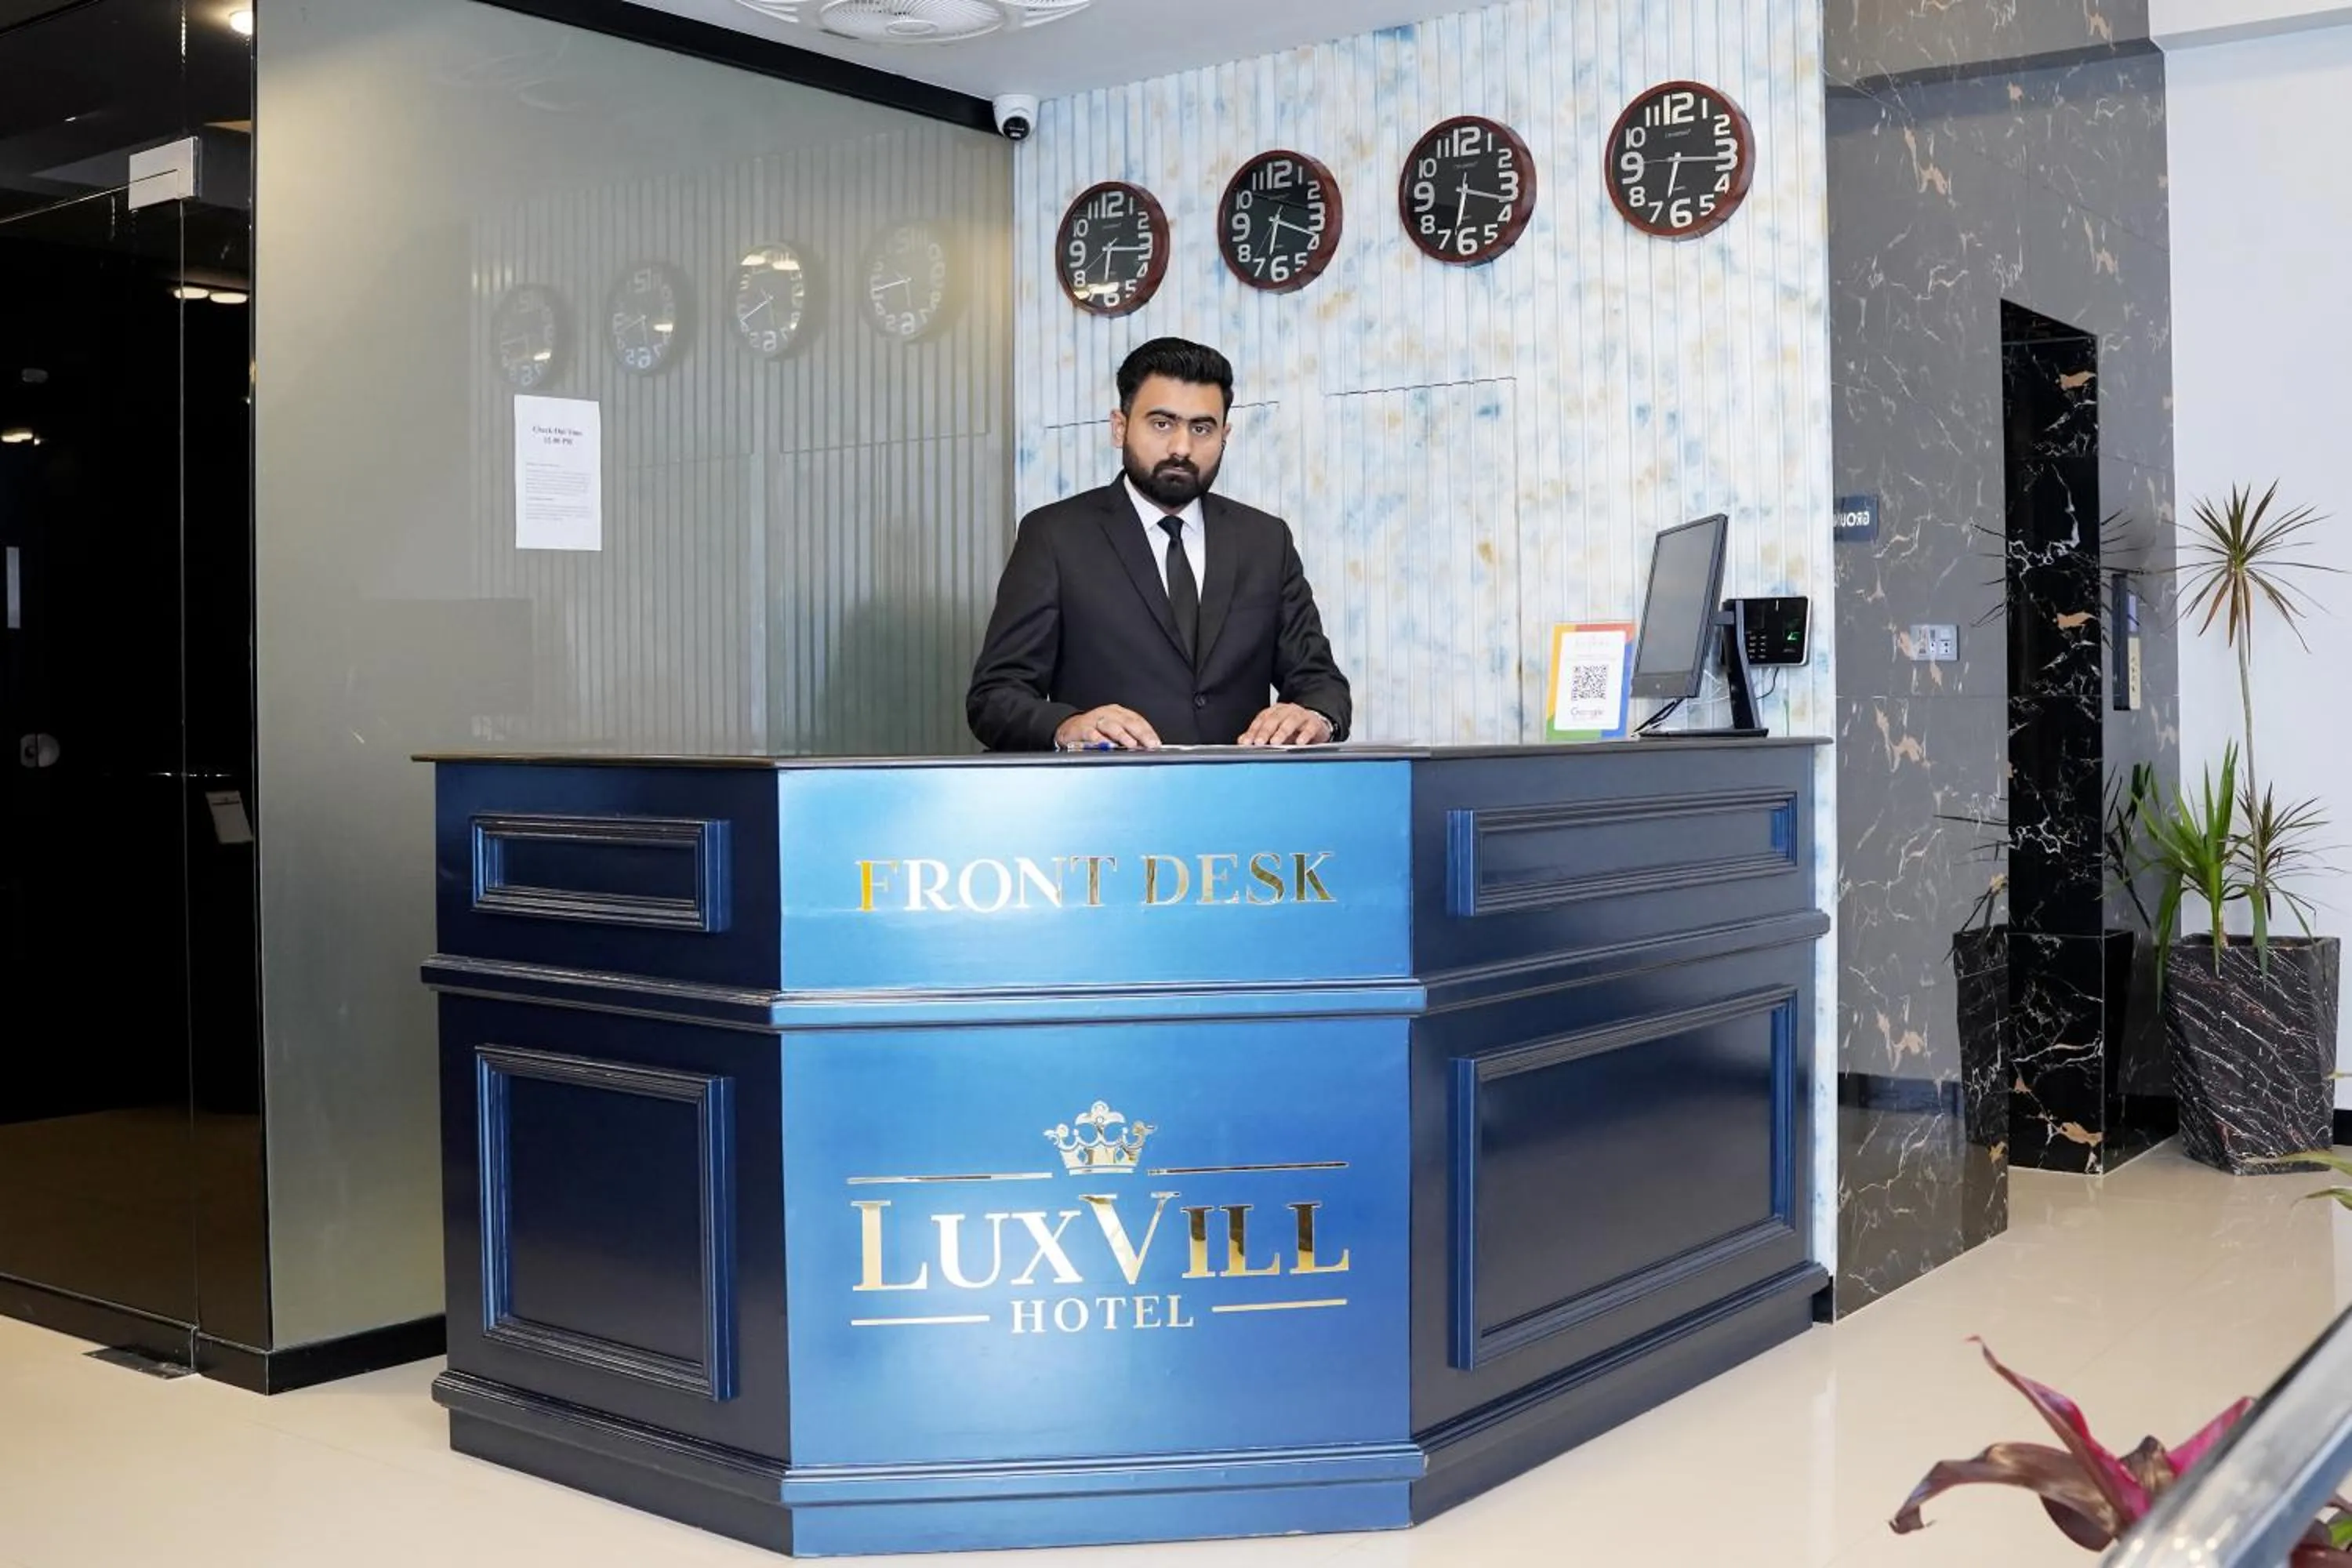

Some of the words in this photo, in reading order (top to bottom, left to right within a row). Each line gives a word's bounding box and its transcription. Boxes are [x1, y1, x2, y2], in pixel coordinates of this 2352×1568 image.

[1646, 105, 1660, 127] 11
[1663, 92, 1694, 125] 12
[1702, 98, 1708, 119] 1
[1713, 114, 1730, 136] 2
[1437, 137, 1449, 159] 11
[1453, 126, 1481, 158] 12
[1487, 132, 1492, 152] 1
[1625, 127, 1646, 150] 10
[1497, 148, 1512, 169] 2
[1715, 137, 1738, 172] 3
[1267, 159, 1293, 190] 12
[1298, 165, 1302, 185] 1
[1418, 158, 1437, 179] 10
[1621, 151, 1645, 185] 9
[1252, 171, 1265, 191] 11
[1307, 180, 1321, 200] 2
[1498, 170, 1519, 203] 3
[1101, 191, 1124, 219] 12
[1236, 190, 1252, 210] 10
[1414, 181, 1435, 212] 9
[1629, 186, 1646, 208] 8
[1699, 194, 1715, 216] 5
[1138, 212, 1149, 229] 2
[1308, 201, 1326, 232] 3
[1648, 200, 1664, 223] 7
[1669, 197, 1693, 228] 6
[1073, 219, 1089, 238] 10
[1232, 212, 1251, 242] 9
[1420, 214, 1436, 234] 8
[1484, 223, 1498, 245] 5
[1138, 232, 1153, 260] 3
[1437, 228, 1451, 250] 7
[1457, 227, 1478, 256] 6
[1069, 240, 1086, 267] 9
[1238, 244, 1251, 263] 8
[1073, 270, 1086, 288] 8
[1253, 258, 1266, 278] 7
[1270, 256, 1290, 282] 6
[855, 856, 1117, 913] FRONT
[1141, 852, 1337, 906] DESK
[1010, 1294, 1195, 1334] HOTEL
